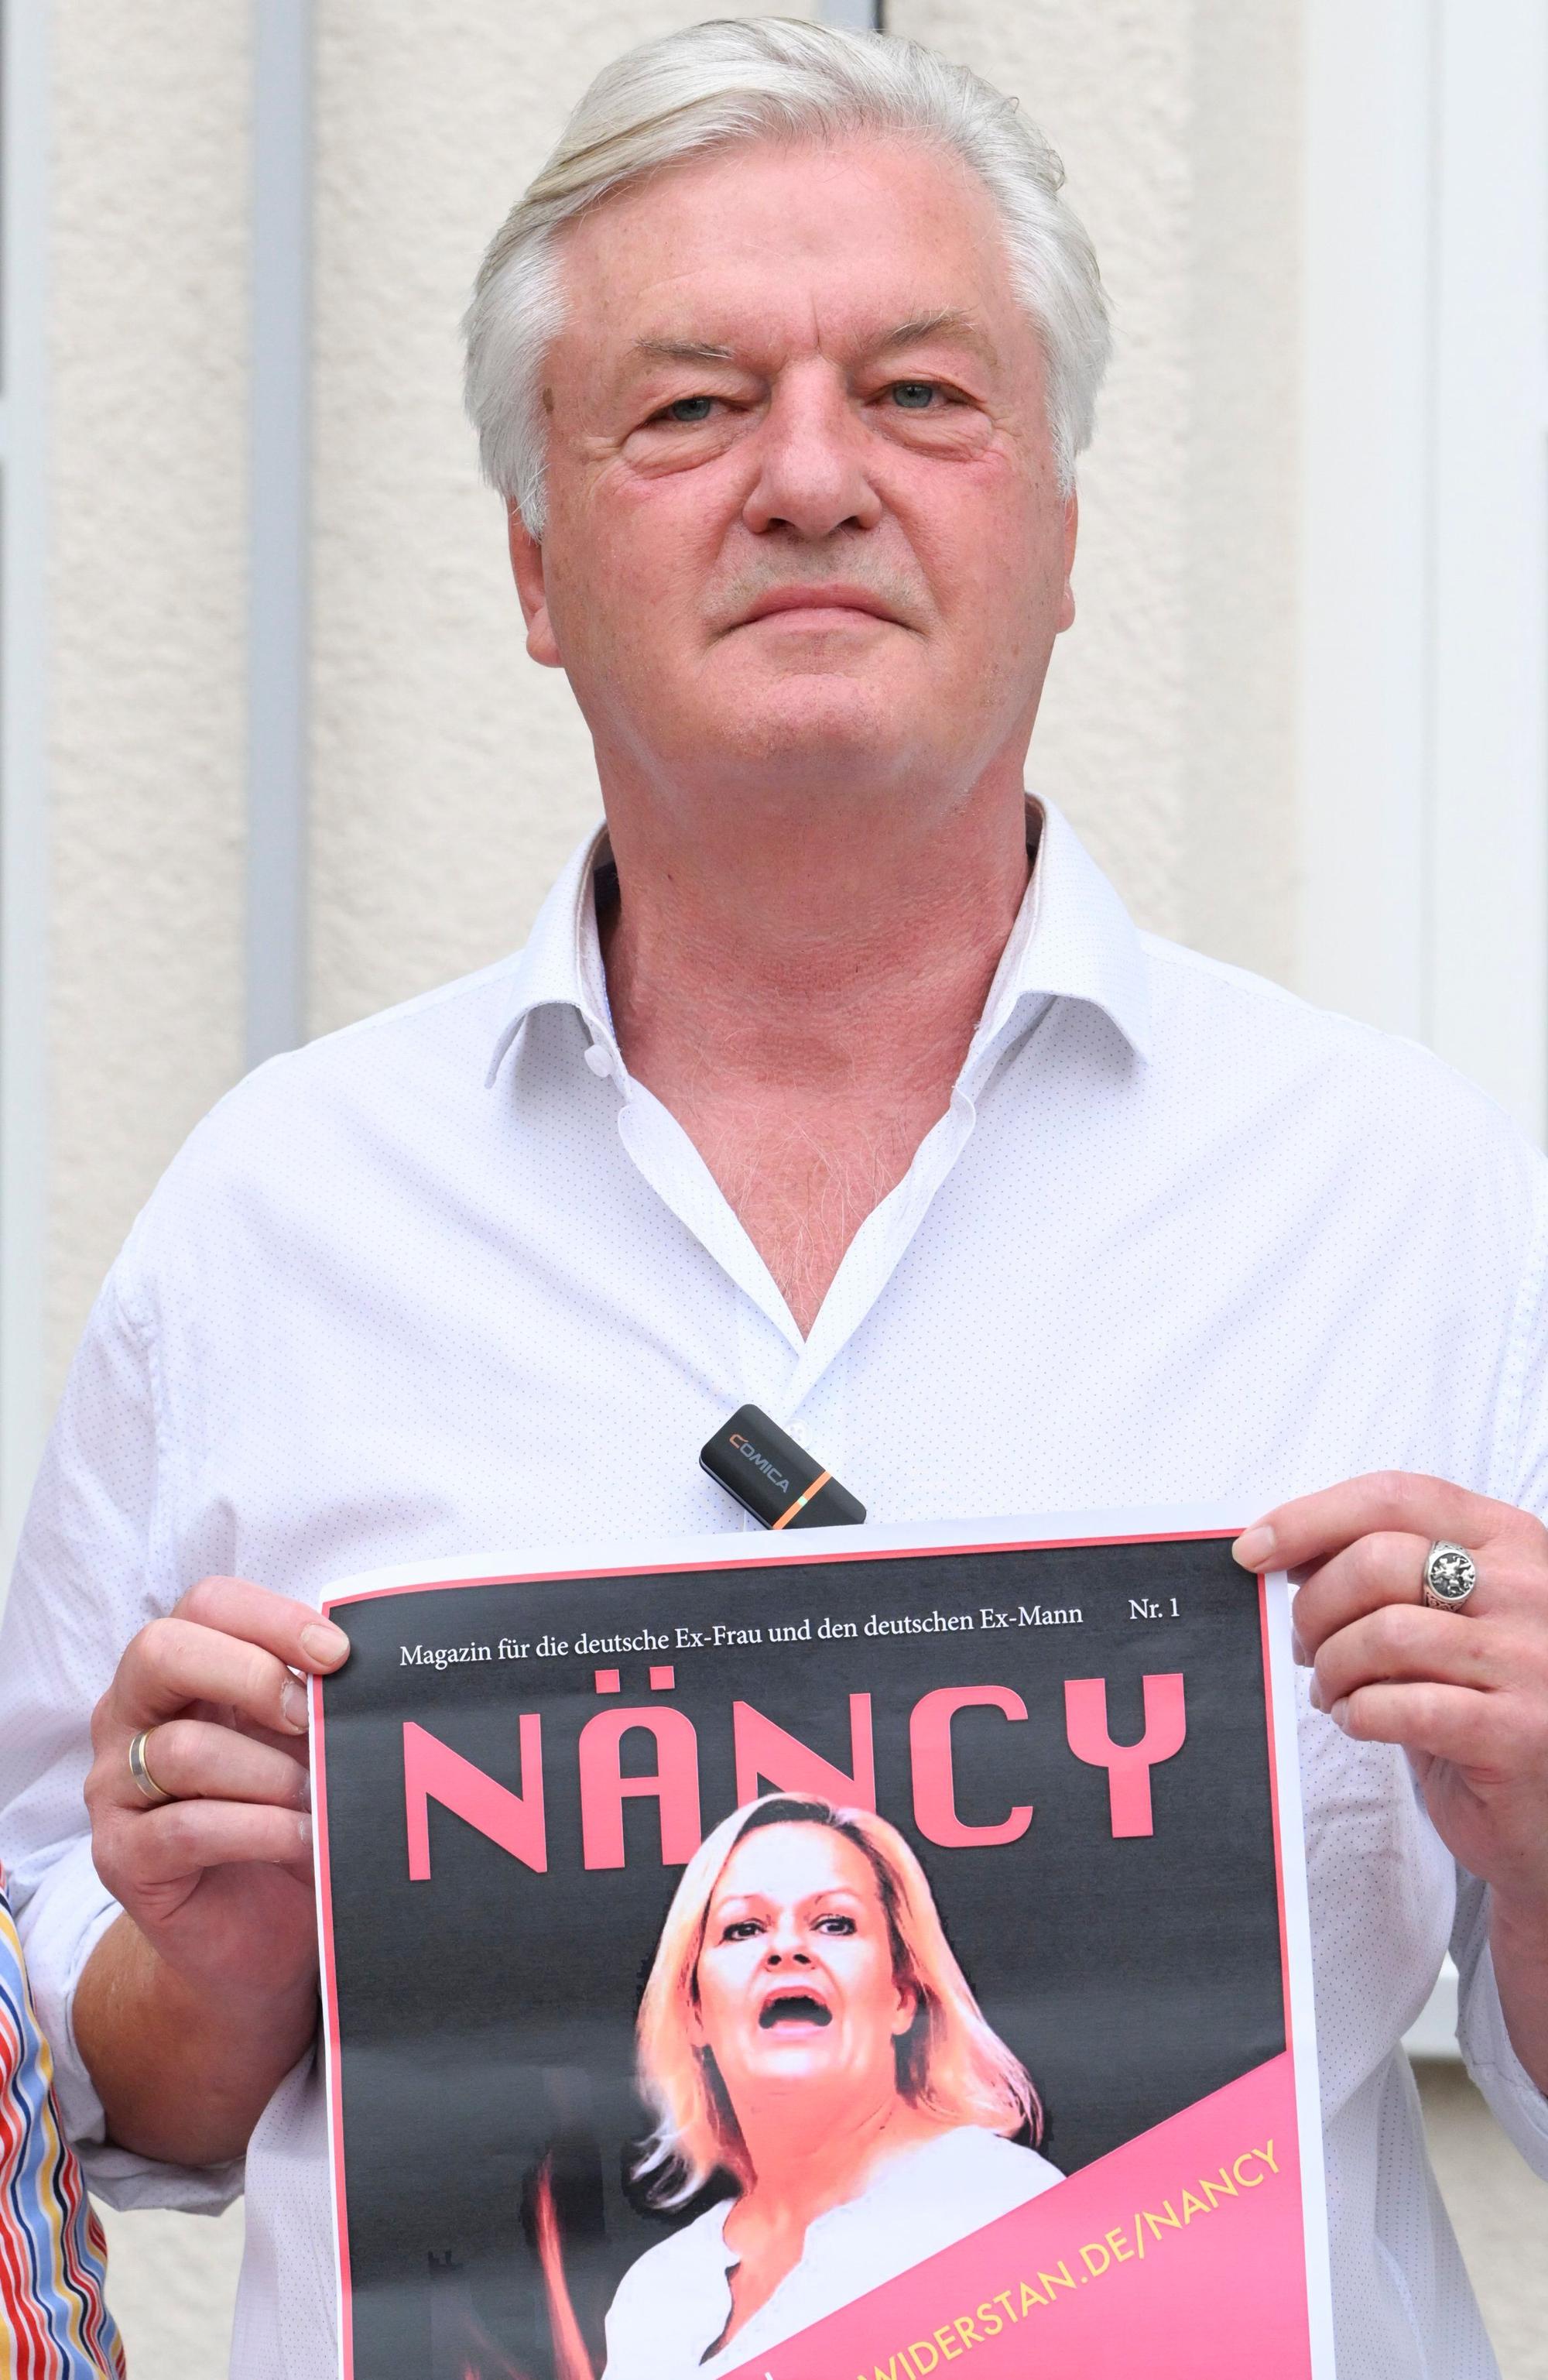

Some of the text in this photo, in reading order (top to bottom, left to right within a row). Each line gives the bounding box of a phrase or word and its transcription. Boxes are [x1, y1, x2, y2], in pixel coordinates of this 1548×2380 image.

[729, 1434, 789, 1494] COMICA
[399, 1597, 1180, 1671] Magazin für die deutsche Ex-Frau und den deutschen Ex-Mann Nr. 1
[403, 1665, 1187, 1881] NÄNCY
